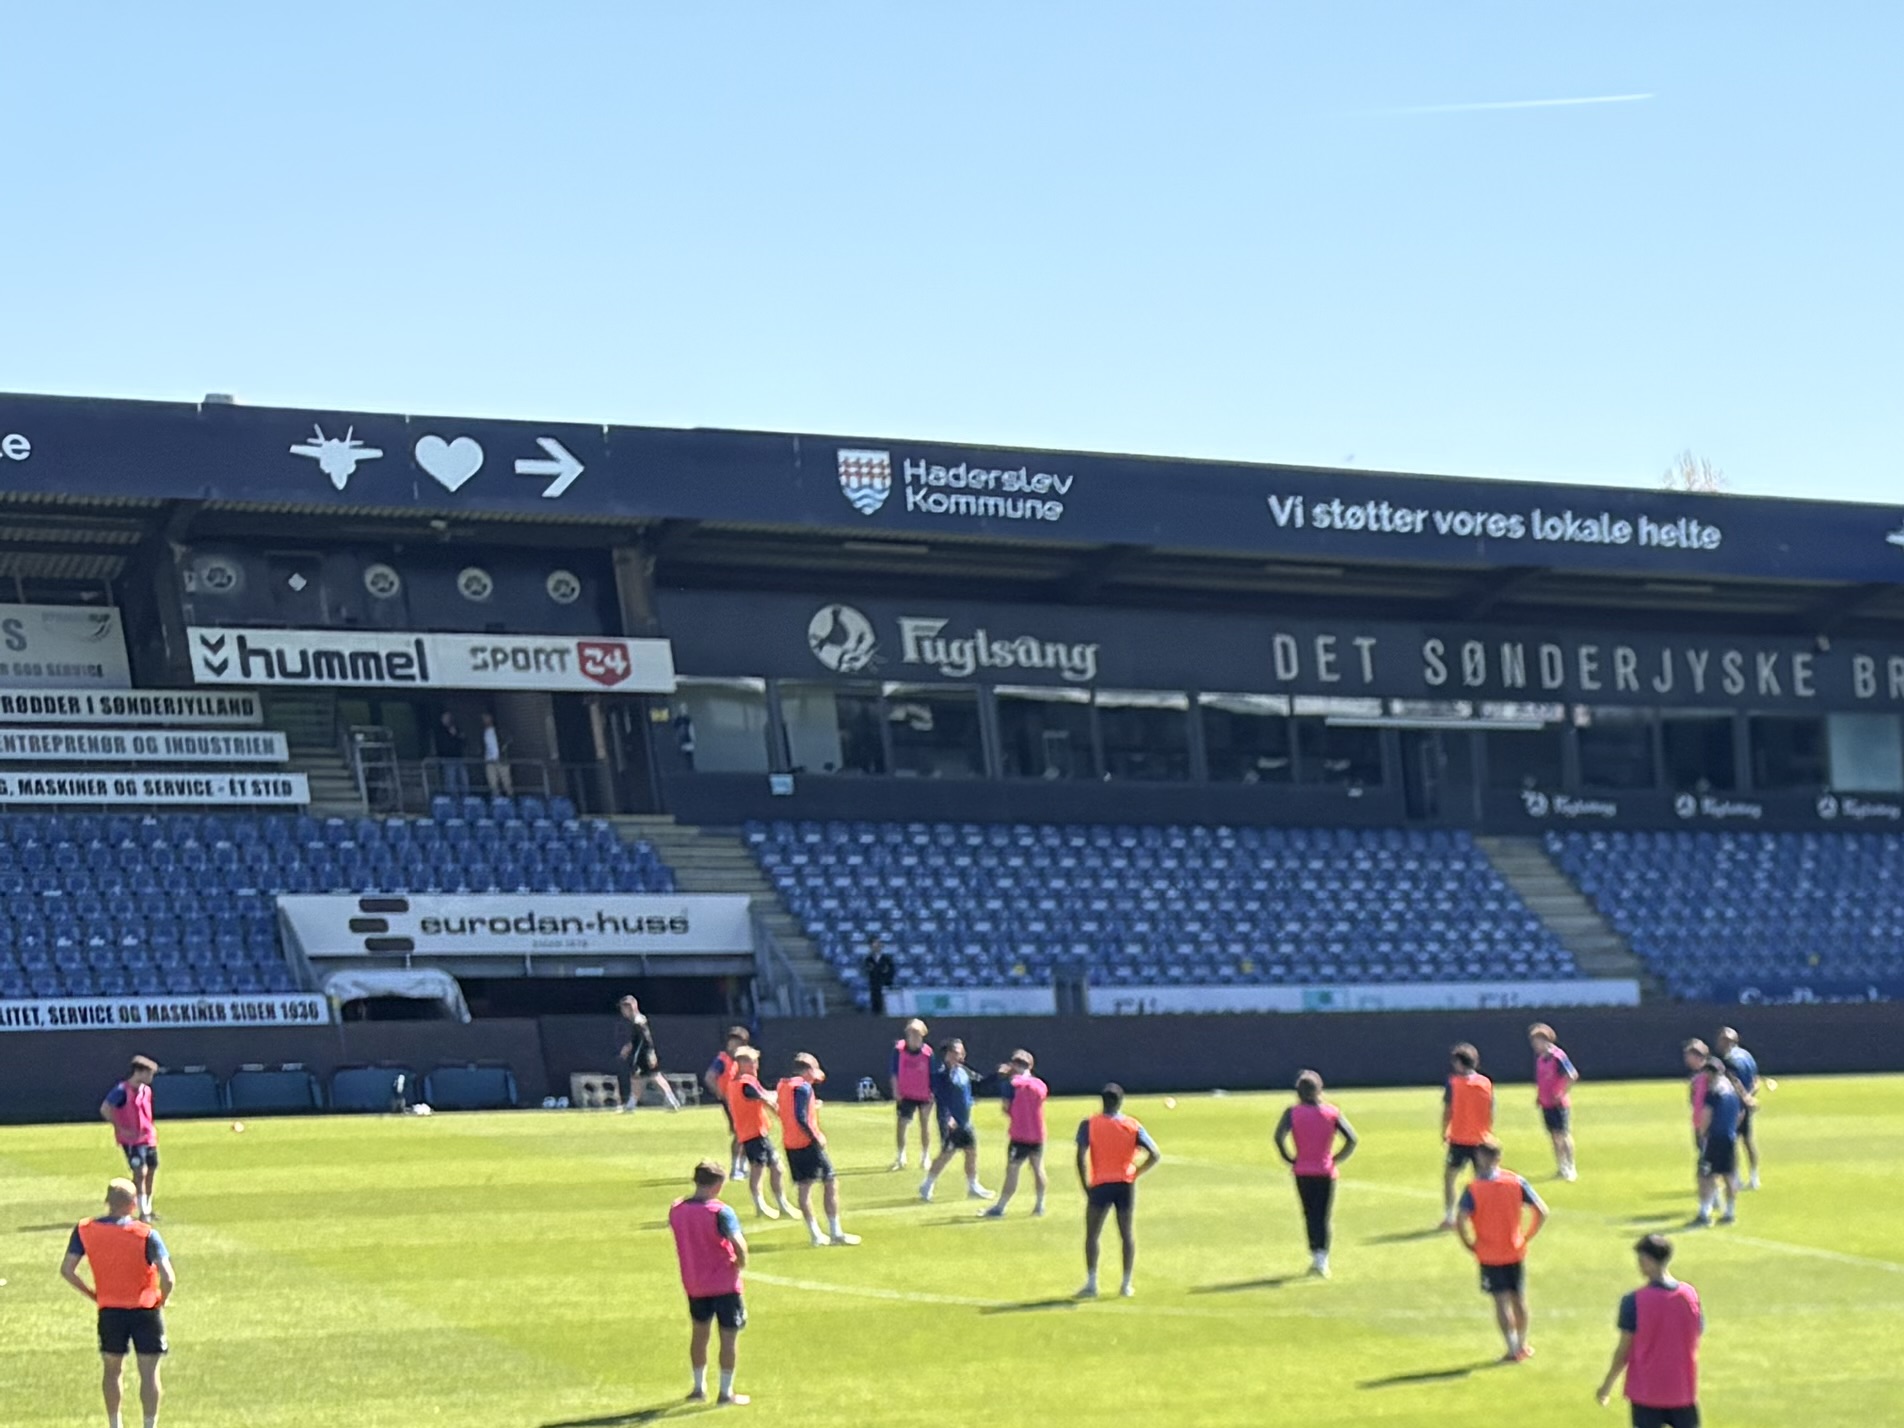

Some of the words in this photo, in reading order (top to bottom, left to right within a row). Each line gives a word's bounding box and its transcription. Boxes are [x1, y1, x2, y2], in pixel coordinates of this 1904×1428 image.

[904, 458, 1073, 496] Haderslev
[905, 487, 1064, 521] Kommune
[1269, 496, 1305, 527] Vi
[1311, 497, 1427, 535] støtter
[1434, 508, 1525, 538] vores
[1531, 508, 1631, 544] lokale
[1639, 516, 1722, 549] helte
[237, 634, 429, 682] hummel
[469, 645, 571, 673] SPORT
[898, 617, 1097, 679] Fuglsang
[1273, 633, 1376, 681] DET
[1424, 637, 1814, 697] SØNDERJYSKE
[101, 696, 254, 717] SØNDERJYLLAND
[133, 737, 158, 754] OG
[165, 736, 275, 755] INDUSTRIEN
[18, 779, 108, 796] MASKINER
[114, 779, 137, 796] OG
[143, 779, 214, 797] SERVICE
[251, 779, 292, 796] STED
[49, 1005, 113, 1025] SERVICE
[145, 1002, 226, 1023] MASKINER
